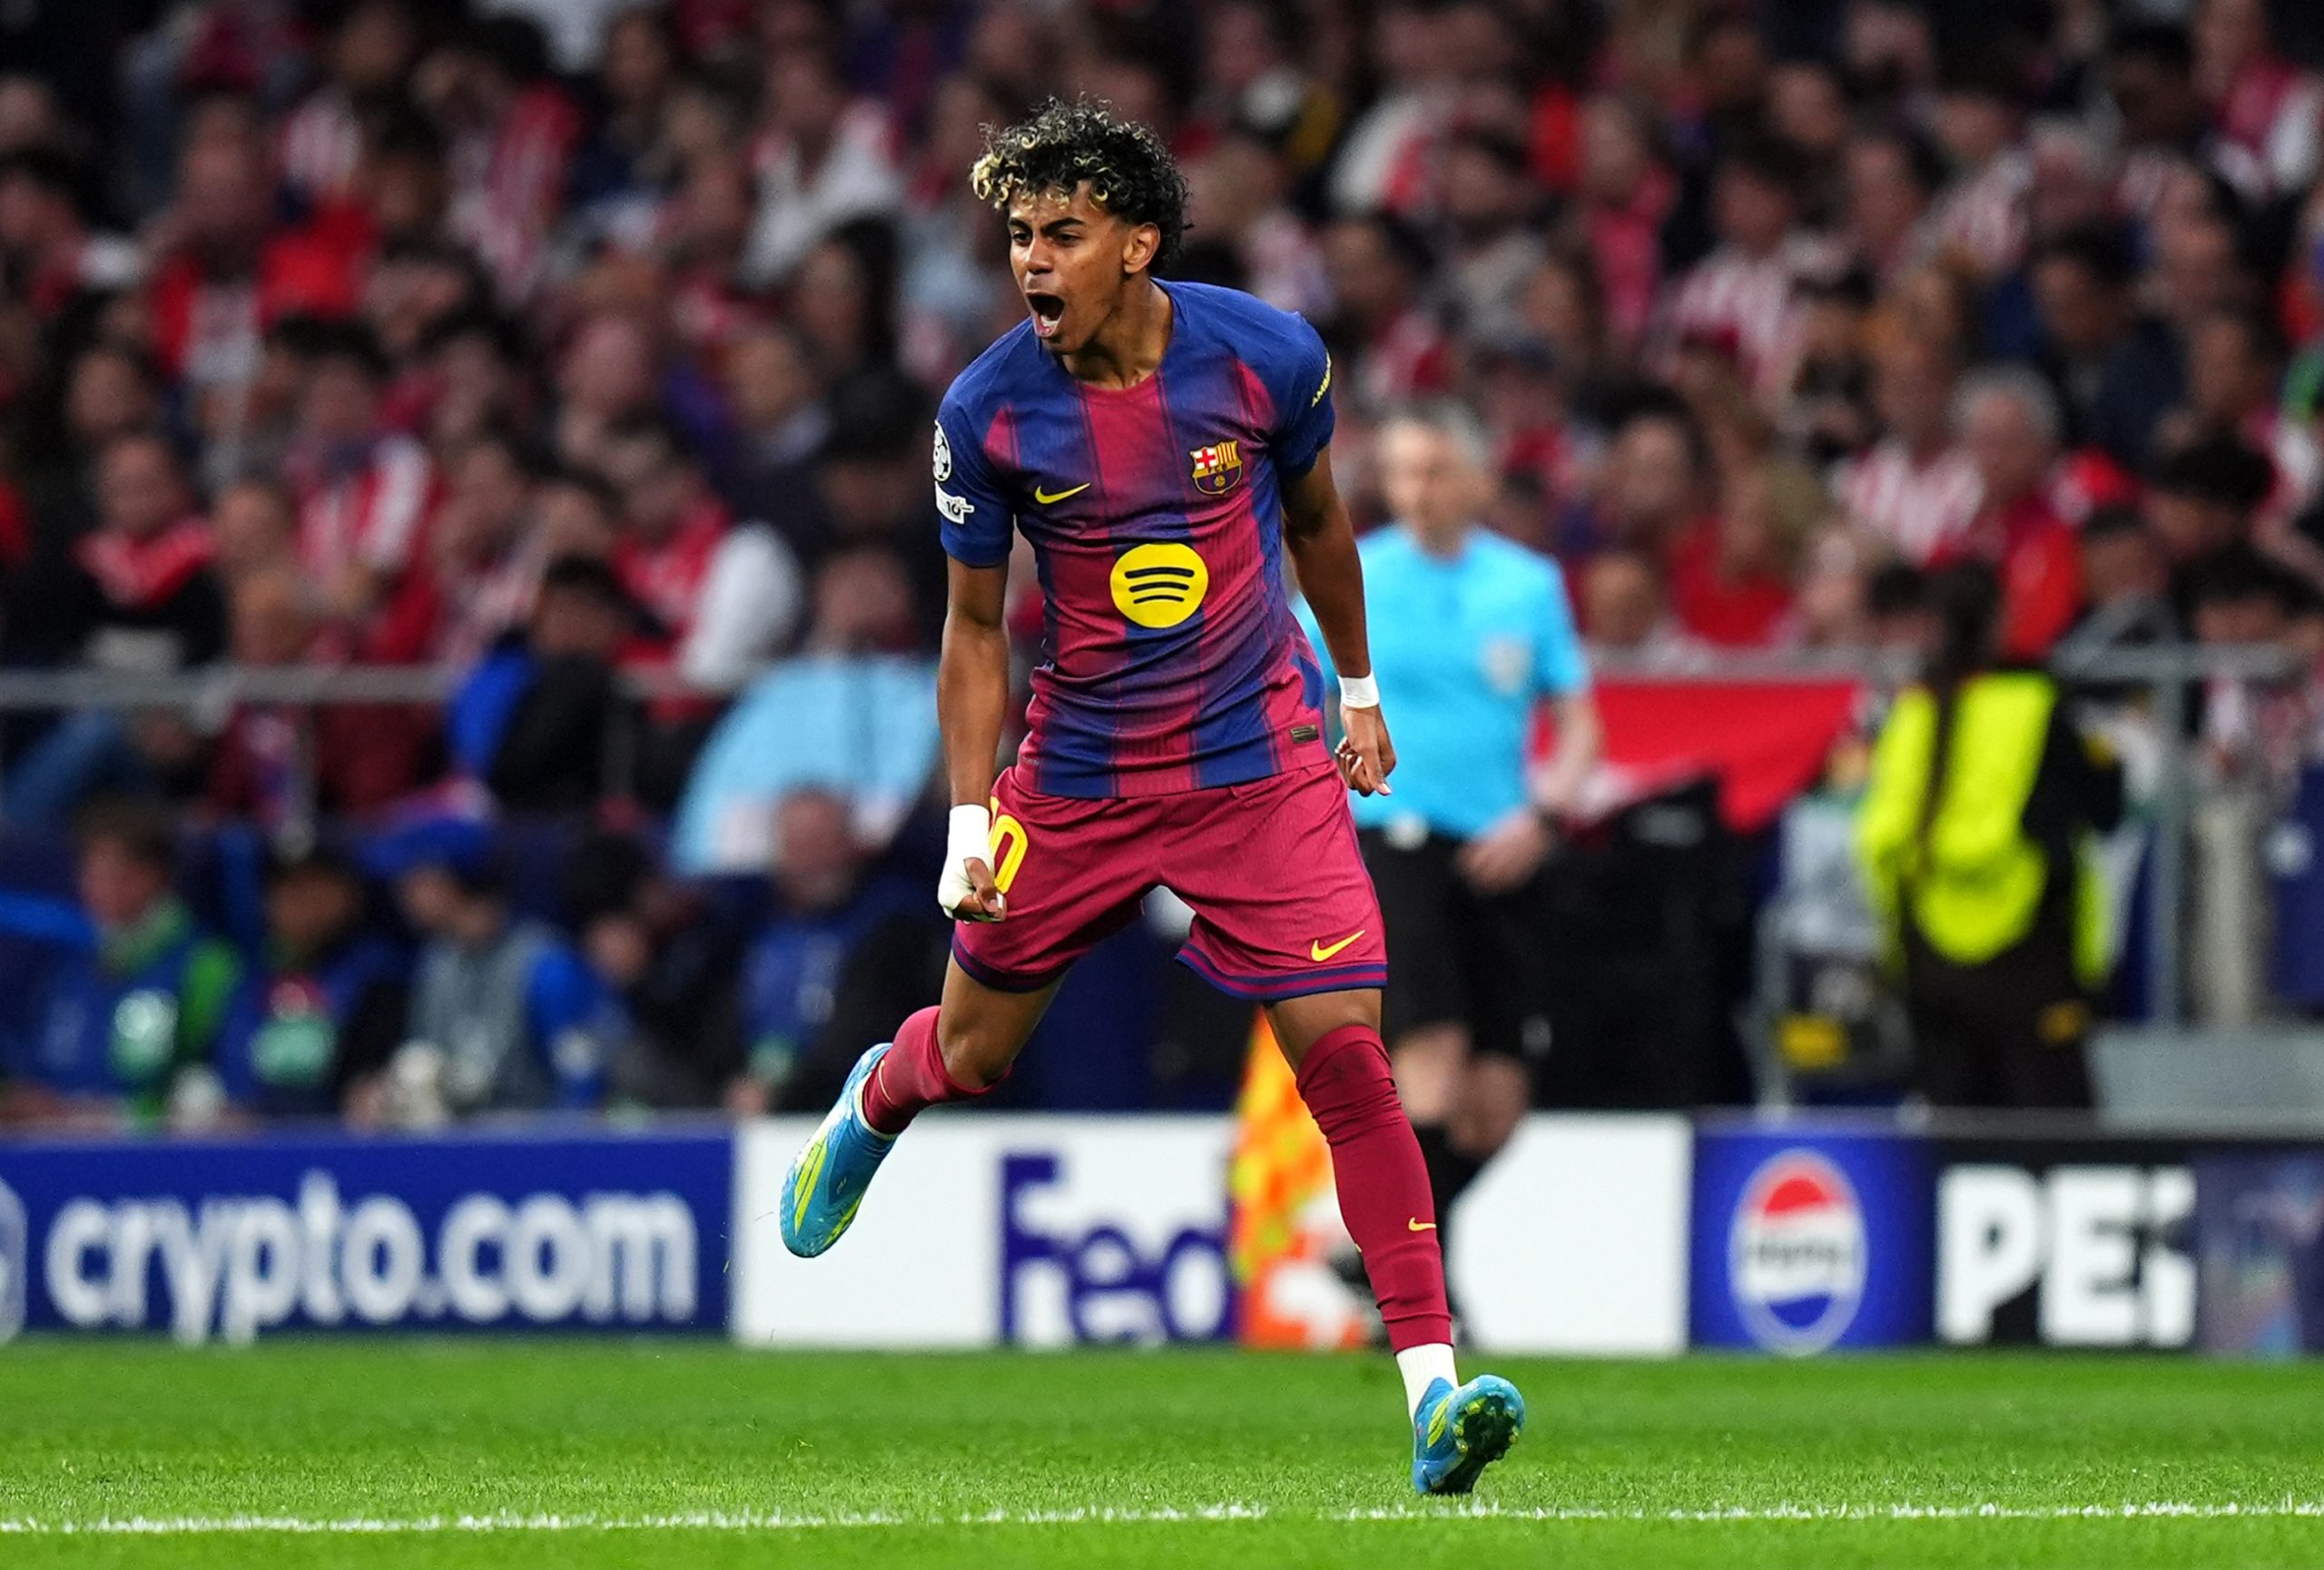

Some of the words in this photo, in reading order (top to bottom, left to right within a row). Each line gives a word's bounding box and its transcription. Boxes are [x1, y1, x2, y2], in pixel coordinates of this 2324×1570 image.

[989, 796, 1029, 894] 0
[45, 1169, 697, 1346] crypto.com
[1001, 1150, 1366, 1346] Fed
